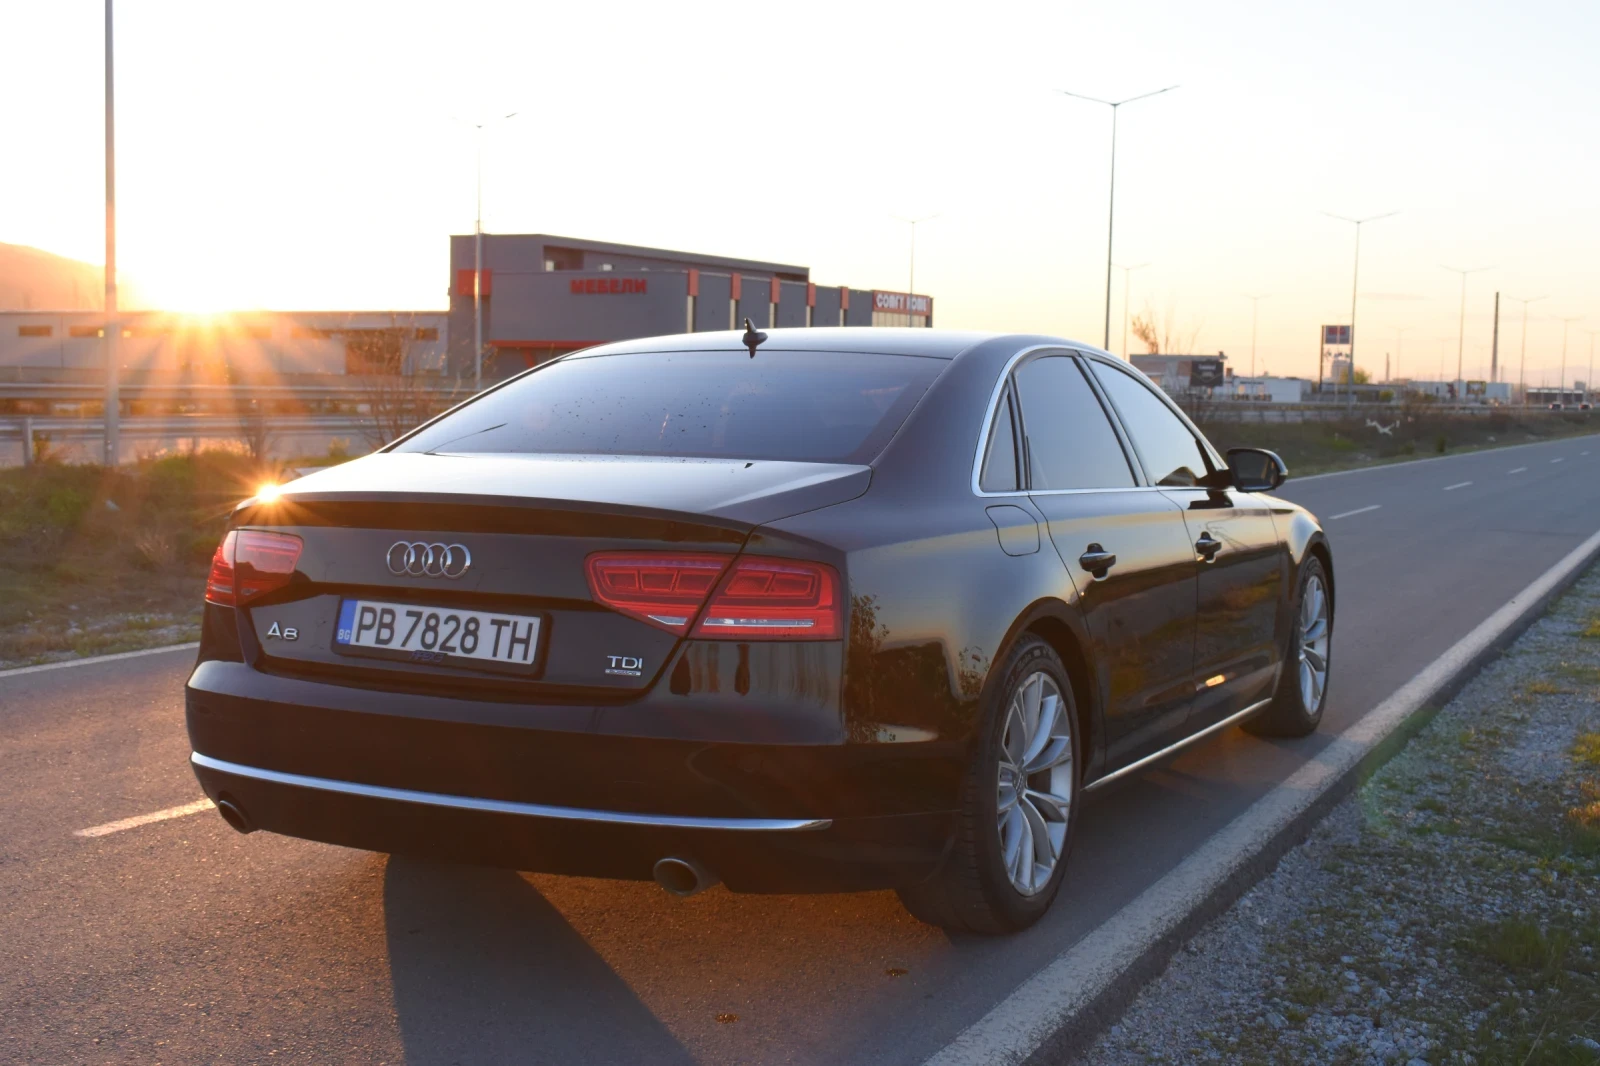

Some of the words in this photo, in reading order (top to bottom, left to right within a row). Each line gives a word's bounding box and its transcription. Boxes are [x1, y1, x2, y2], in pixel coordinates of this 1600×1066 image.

[571, 278, 647, 294] МЕБЕЛИ
[267, 621, 298, 640] A8
[337, 628, 351, 641] BG
[355, 606, 396, 646] PB
[401, 610, 480, 654] 7828
[490, 618, 534, 661] TH
[606, 655, 643, 669] TDI
